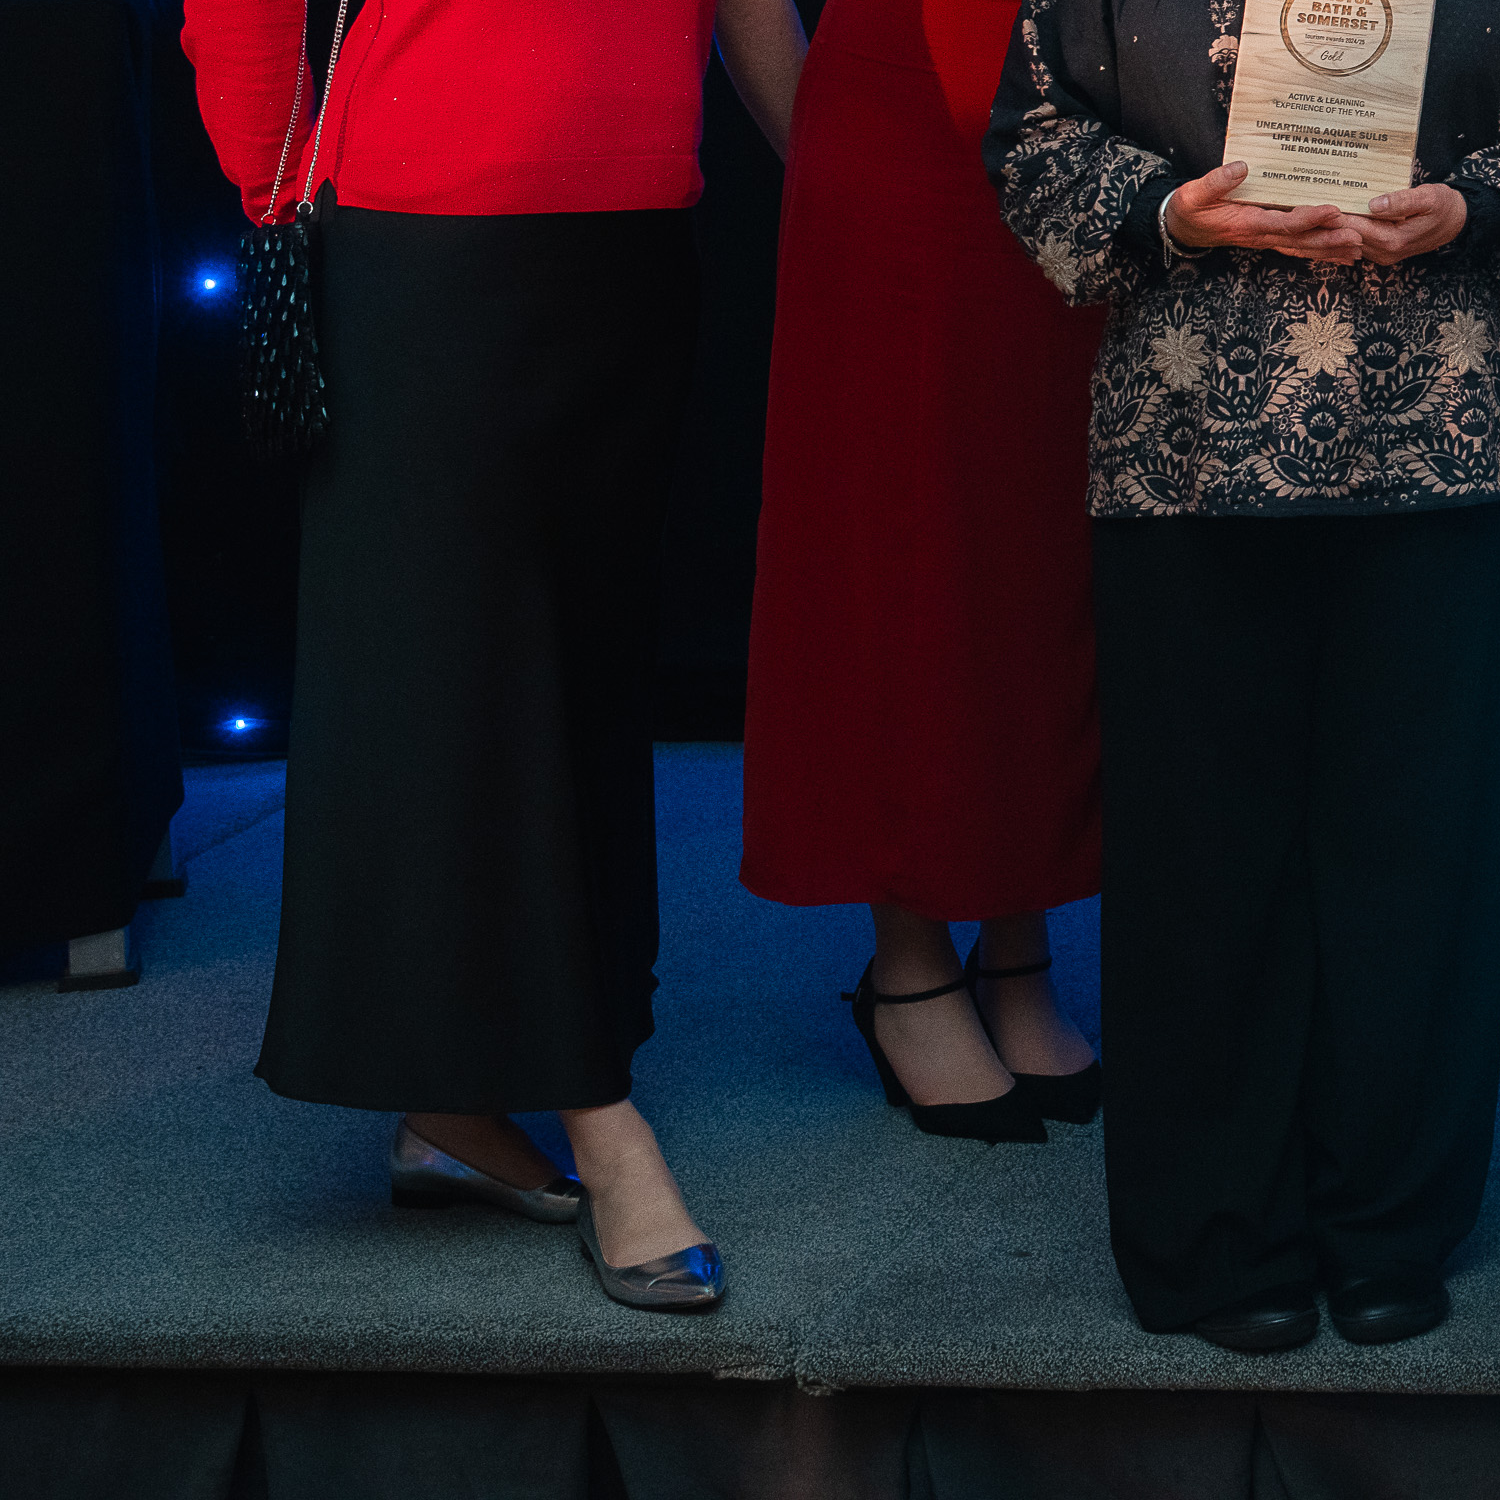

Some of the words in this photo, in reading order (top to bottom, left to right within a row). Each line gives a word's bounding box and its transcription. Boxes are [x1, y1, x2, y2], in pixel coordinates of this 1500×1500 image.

[1312, 2, 1353, 15] BATH
[1356, 7, 1367, 17] &
[1297, 12, 1379, 31] SOMERSET
[1320, 50, 1345, 61] Gold
[1288, 93, 1315, 102] ACTIVE
[1325, 97, 1365, 108] LEARNING
[1275, 100, 1324, 112] EXPERIENCE
[1354, 109, 1376, 118] YEAR
[1256, 121, 1321, 134] UNEARTHING
[1322, 128, 1357, 138] AQUAE
[1358, 132, 1388, 142] SULIS
[1272, 133, 1290, 141] LIFE
[1311, 138, 1342, 147] ROMAN
[1344, 141, 1369, 150] TOWN
[1280, 144, 1296, 152] THE
[1298, 146, 1330, 155] ROMAN
[1331, 149, 1358, 158] BATHS
[1262, 172, 1311, 183] SUNFLOWER
[1312, 177, 1342, 186] SOCIAL
[1293, 167, 1330, 176] SPONSORED
